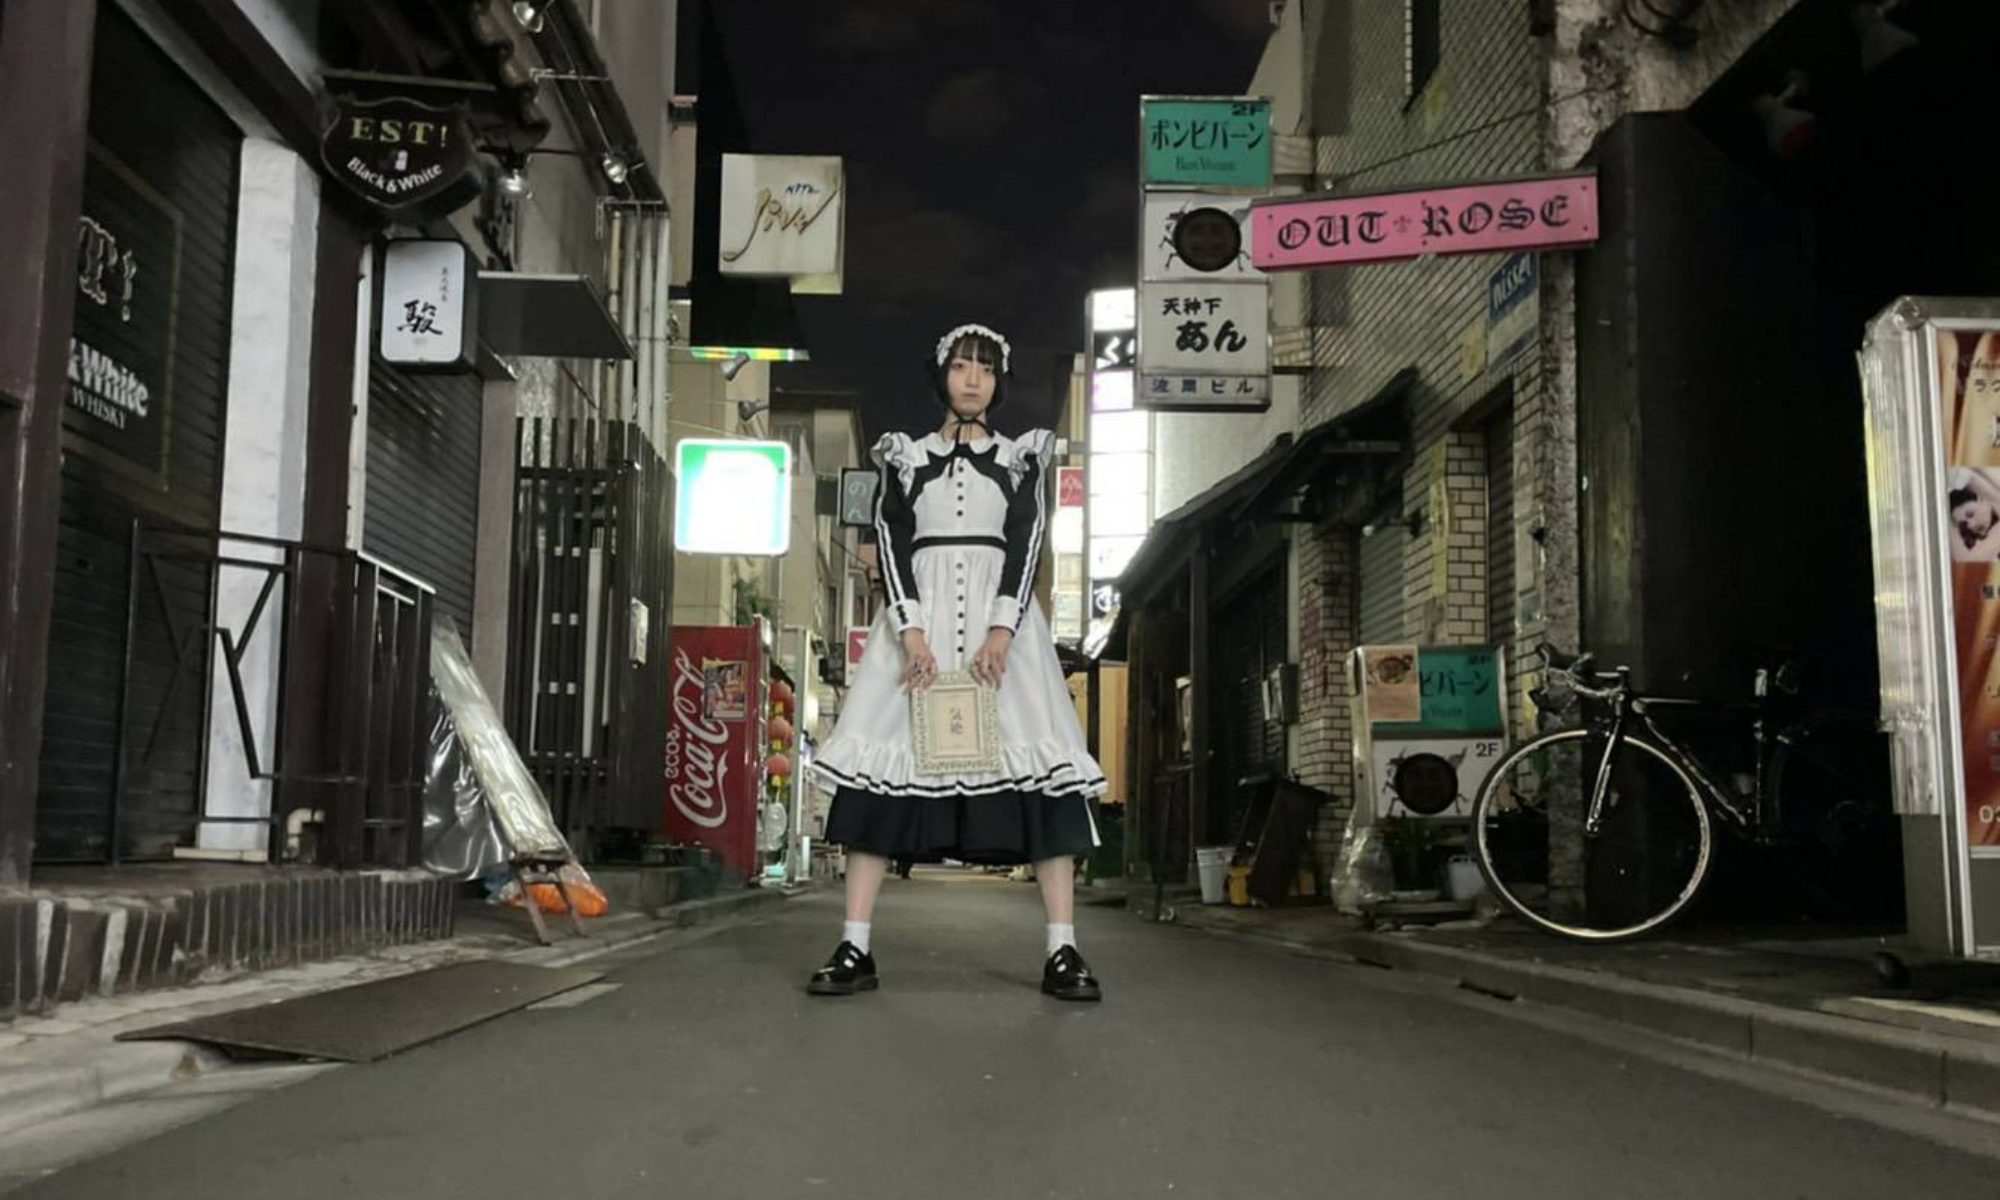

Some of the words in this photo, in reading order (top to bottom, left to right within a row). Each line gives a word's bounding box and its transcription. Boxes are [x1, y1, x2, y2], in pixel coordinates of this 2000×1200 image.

[350, 117, 448, 148] EST!
[1277, 211, 1388, 250] OUT
[1421, 195, 1571, 238] ROSE
[1162, 297, 1222, 316] 天神下
[1176, 319, 1248, 353] あん
[1476, 742, 1499, 757] 2F
